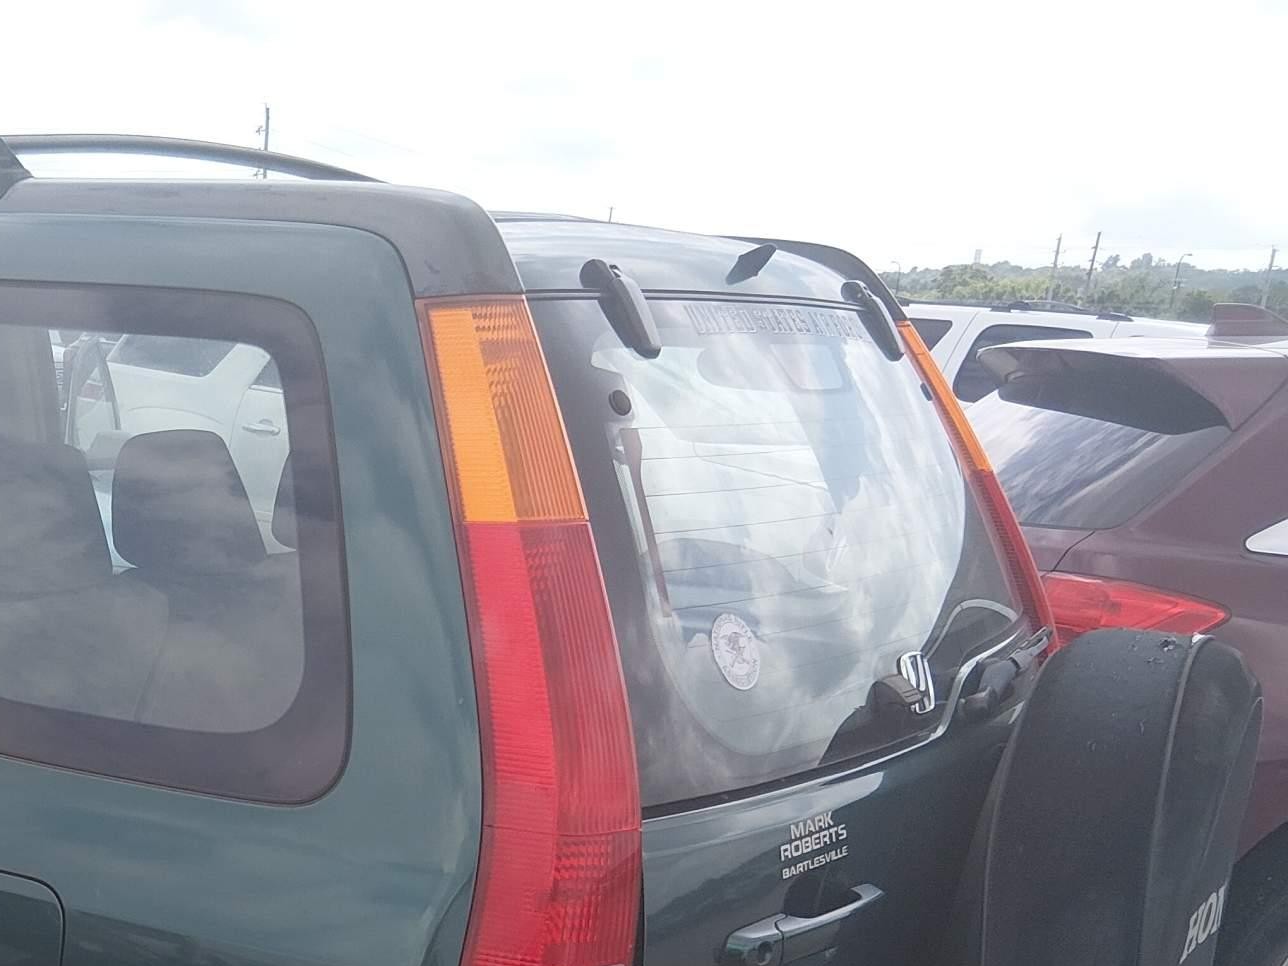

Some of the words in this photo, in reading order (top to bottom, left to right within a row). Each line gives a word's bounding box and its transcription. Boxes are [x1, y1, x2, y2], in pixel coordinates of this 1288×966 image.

[684, 303, 758, 336] UNITED
[755, 307, 811, 334] STATES
[790, 810, 834, 840] MARK
[780, 823, 847, 862] ROBERTS
[782, 845, 849, 879] BARTLESVILLE
